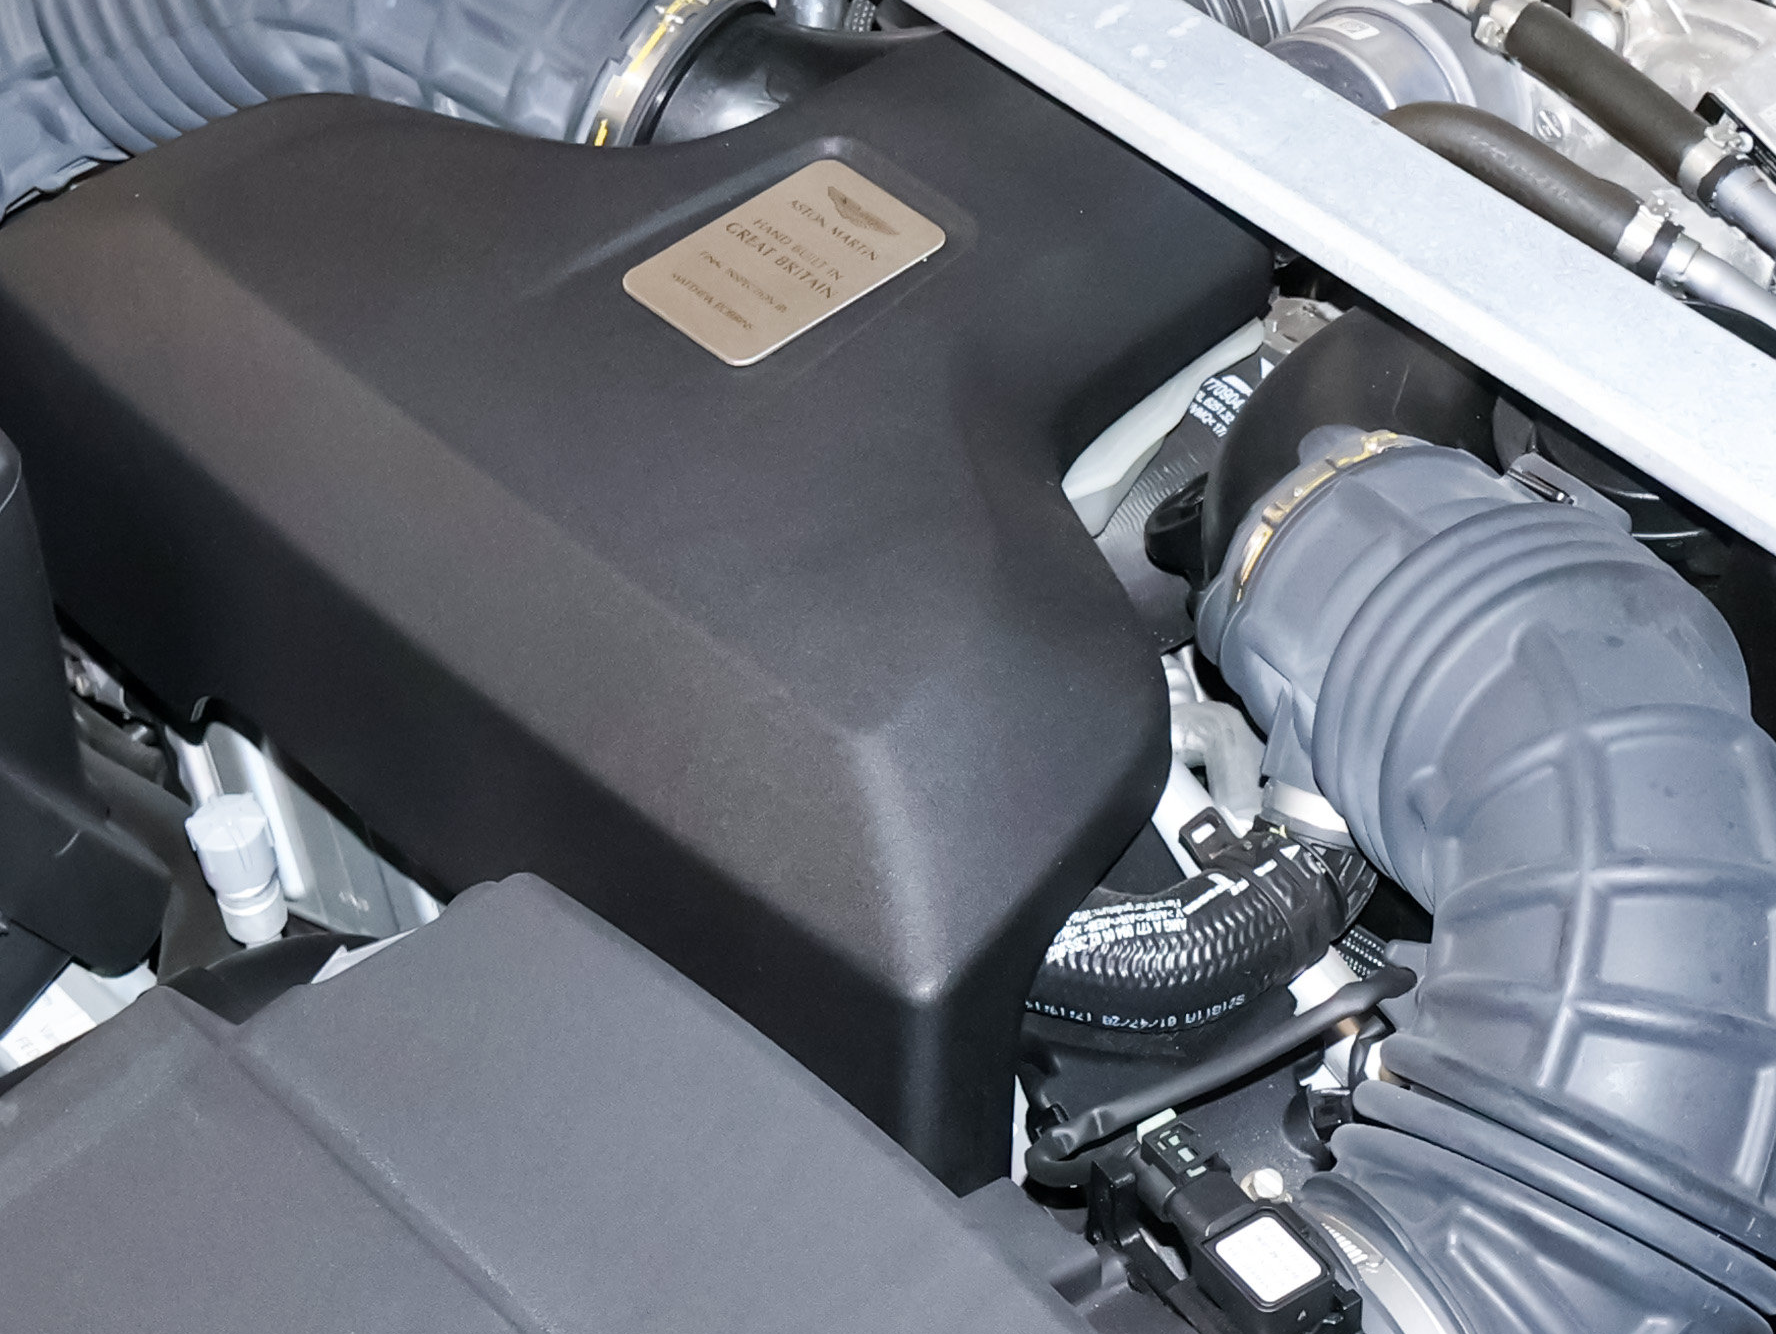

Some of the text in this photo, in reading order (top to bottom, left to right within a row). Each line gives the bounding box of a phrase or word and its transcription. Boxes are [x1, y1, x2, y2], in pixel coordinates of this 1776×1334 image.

[725, 222, 837, 299] GREAT BRITAIN
[752, 219, 843, 282] HAND BUILT IN
[790, 199, 878, 261] ASTON MARTIN
